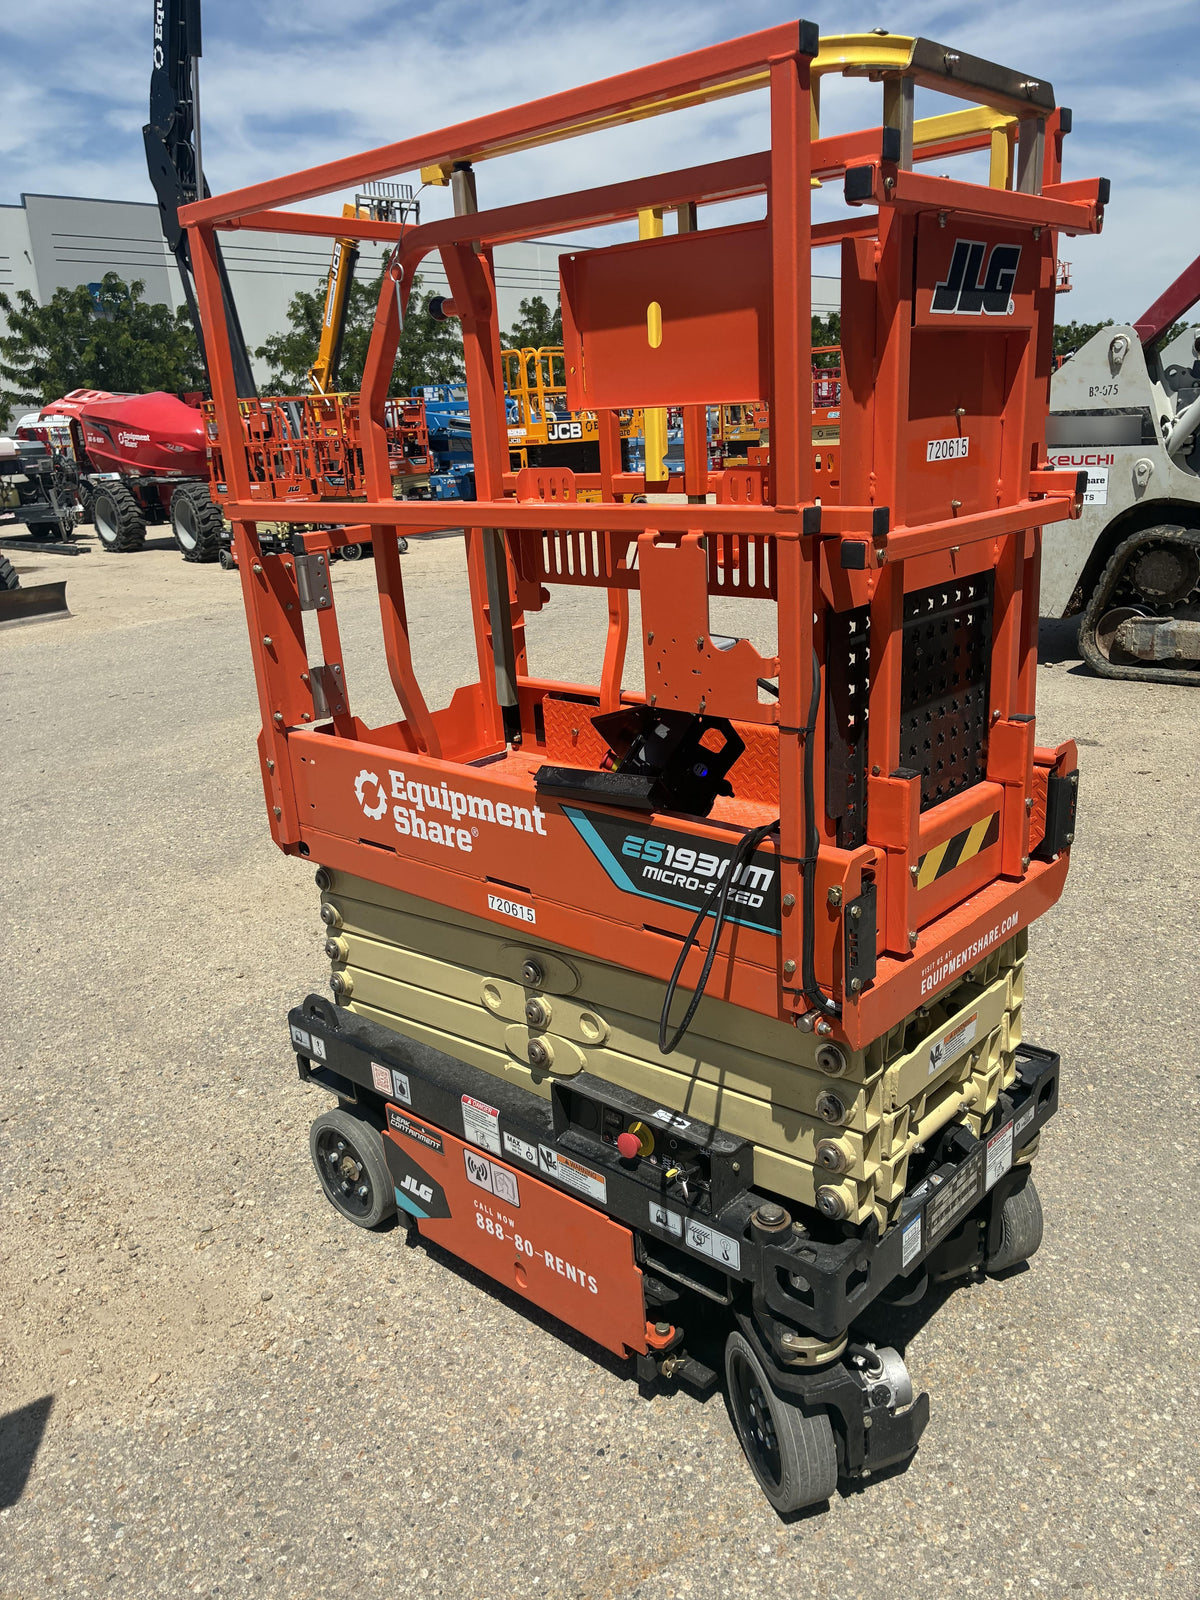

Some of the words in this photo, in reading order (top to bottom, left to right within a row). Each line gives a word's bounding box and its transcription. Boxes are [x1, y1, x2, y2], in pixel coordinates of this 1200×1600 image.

[332, 242, 342, 280] JCB
[549, 423, 582, 439] JCB
[928, 438, 968, 461] 720615
[288, 485, 300, 493] JLG
[388, 769, 547, 836] Equipment
[622, 835, 775, 892] ES1930M
[489, 895, 534, 922] 720615
[920, 911, 1020, 995] EQUIPMENTSHARE.COM
[390, 1119, 441, 1149] CONTAINMENT
[391, 1113, 411, 1127] LEAK
[400, 1174, 434, 1203] JLG
[473, 1199, 494, 1217] CALL
[496, 1211, 515, 1228] NOW
[475, 1212, 599, 1295] 888-80-RENTS
